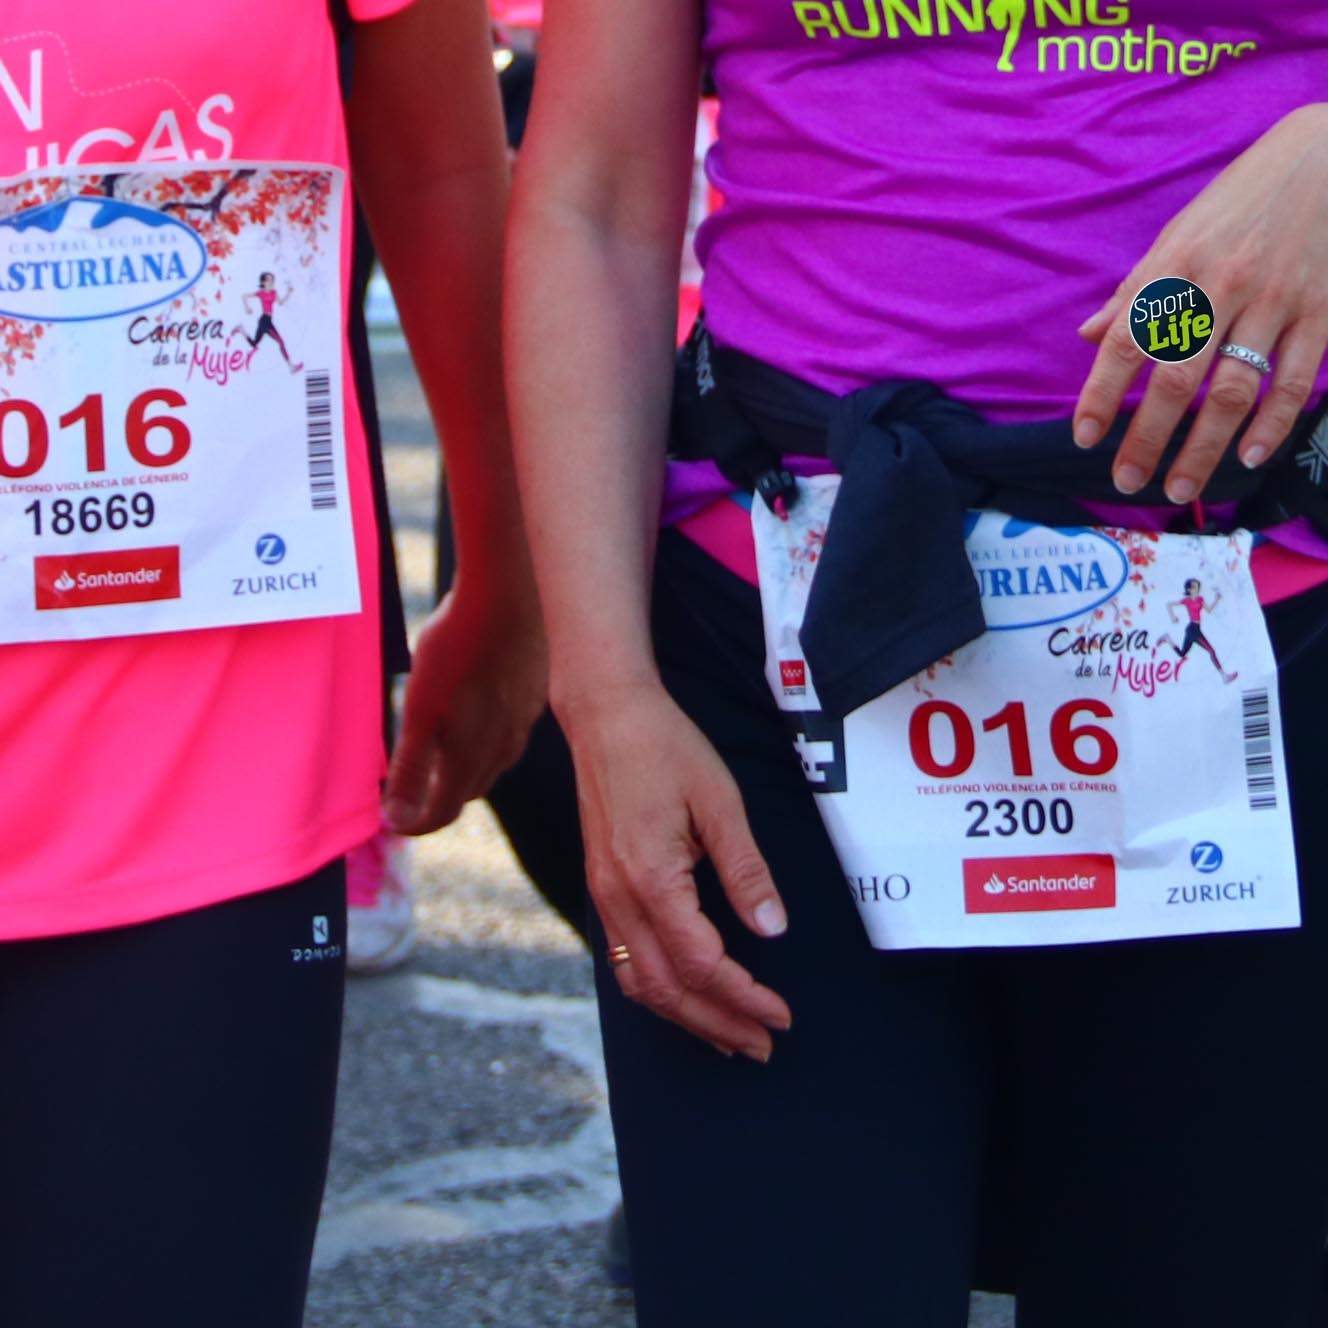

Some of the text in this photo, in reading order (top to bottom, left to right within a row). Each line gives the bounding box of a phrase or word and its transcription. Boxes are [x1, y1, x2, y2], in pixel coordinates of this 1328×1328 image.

[8, 232, 178, 255] CENTRAL LECHERA
[127, 315, 224, 346] Carrera
[152, 336, 260, 386] de la Mujer
[56, 478, 119, 492] VIOLENCIA
[122, 476, 137, 488] DE
[24, 491, 156, 537] 18669
[76, 566, 163, 593] Santander
[231, 571, 318, 597] ZURICH
[1047, 626, 1151, 657] Carrera
[1074, 647, 1188, 698] de la Mujer
[907, 697, 1120, 779] 016
[983, 781, 1048, 793] VIOLENCIA
[1051, 781, 1067, 793] DE
[963, 797, 1075, 838] 2300
[1006, 872, 1097, 893] Santander
[1165, 880, 1256, 906] ZURICH
